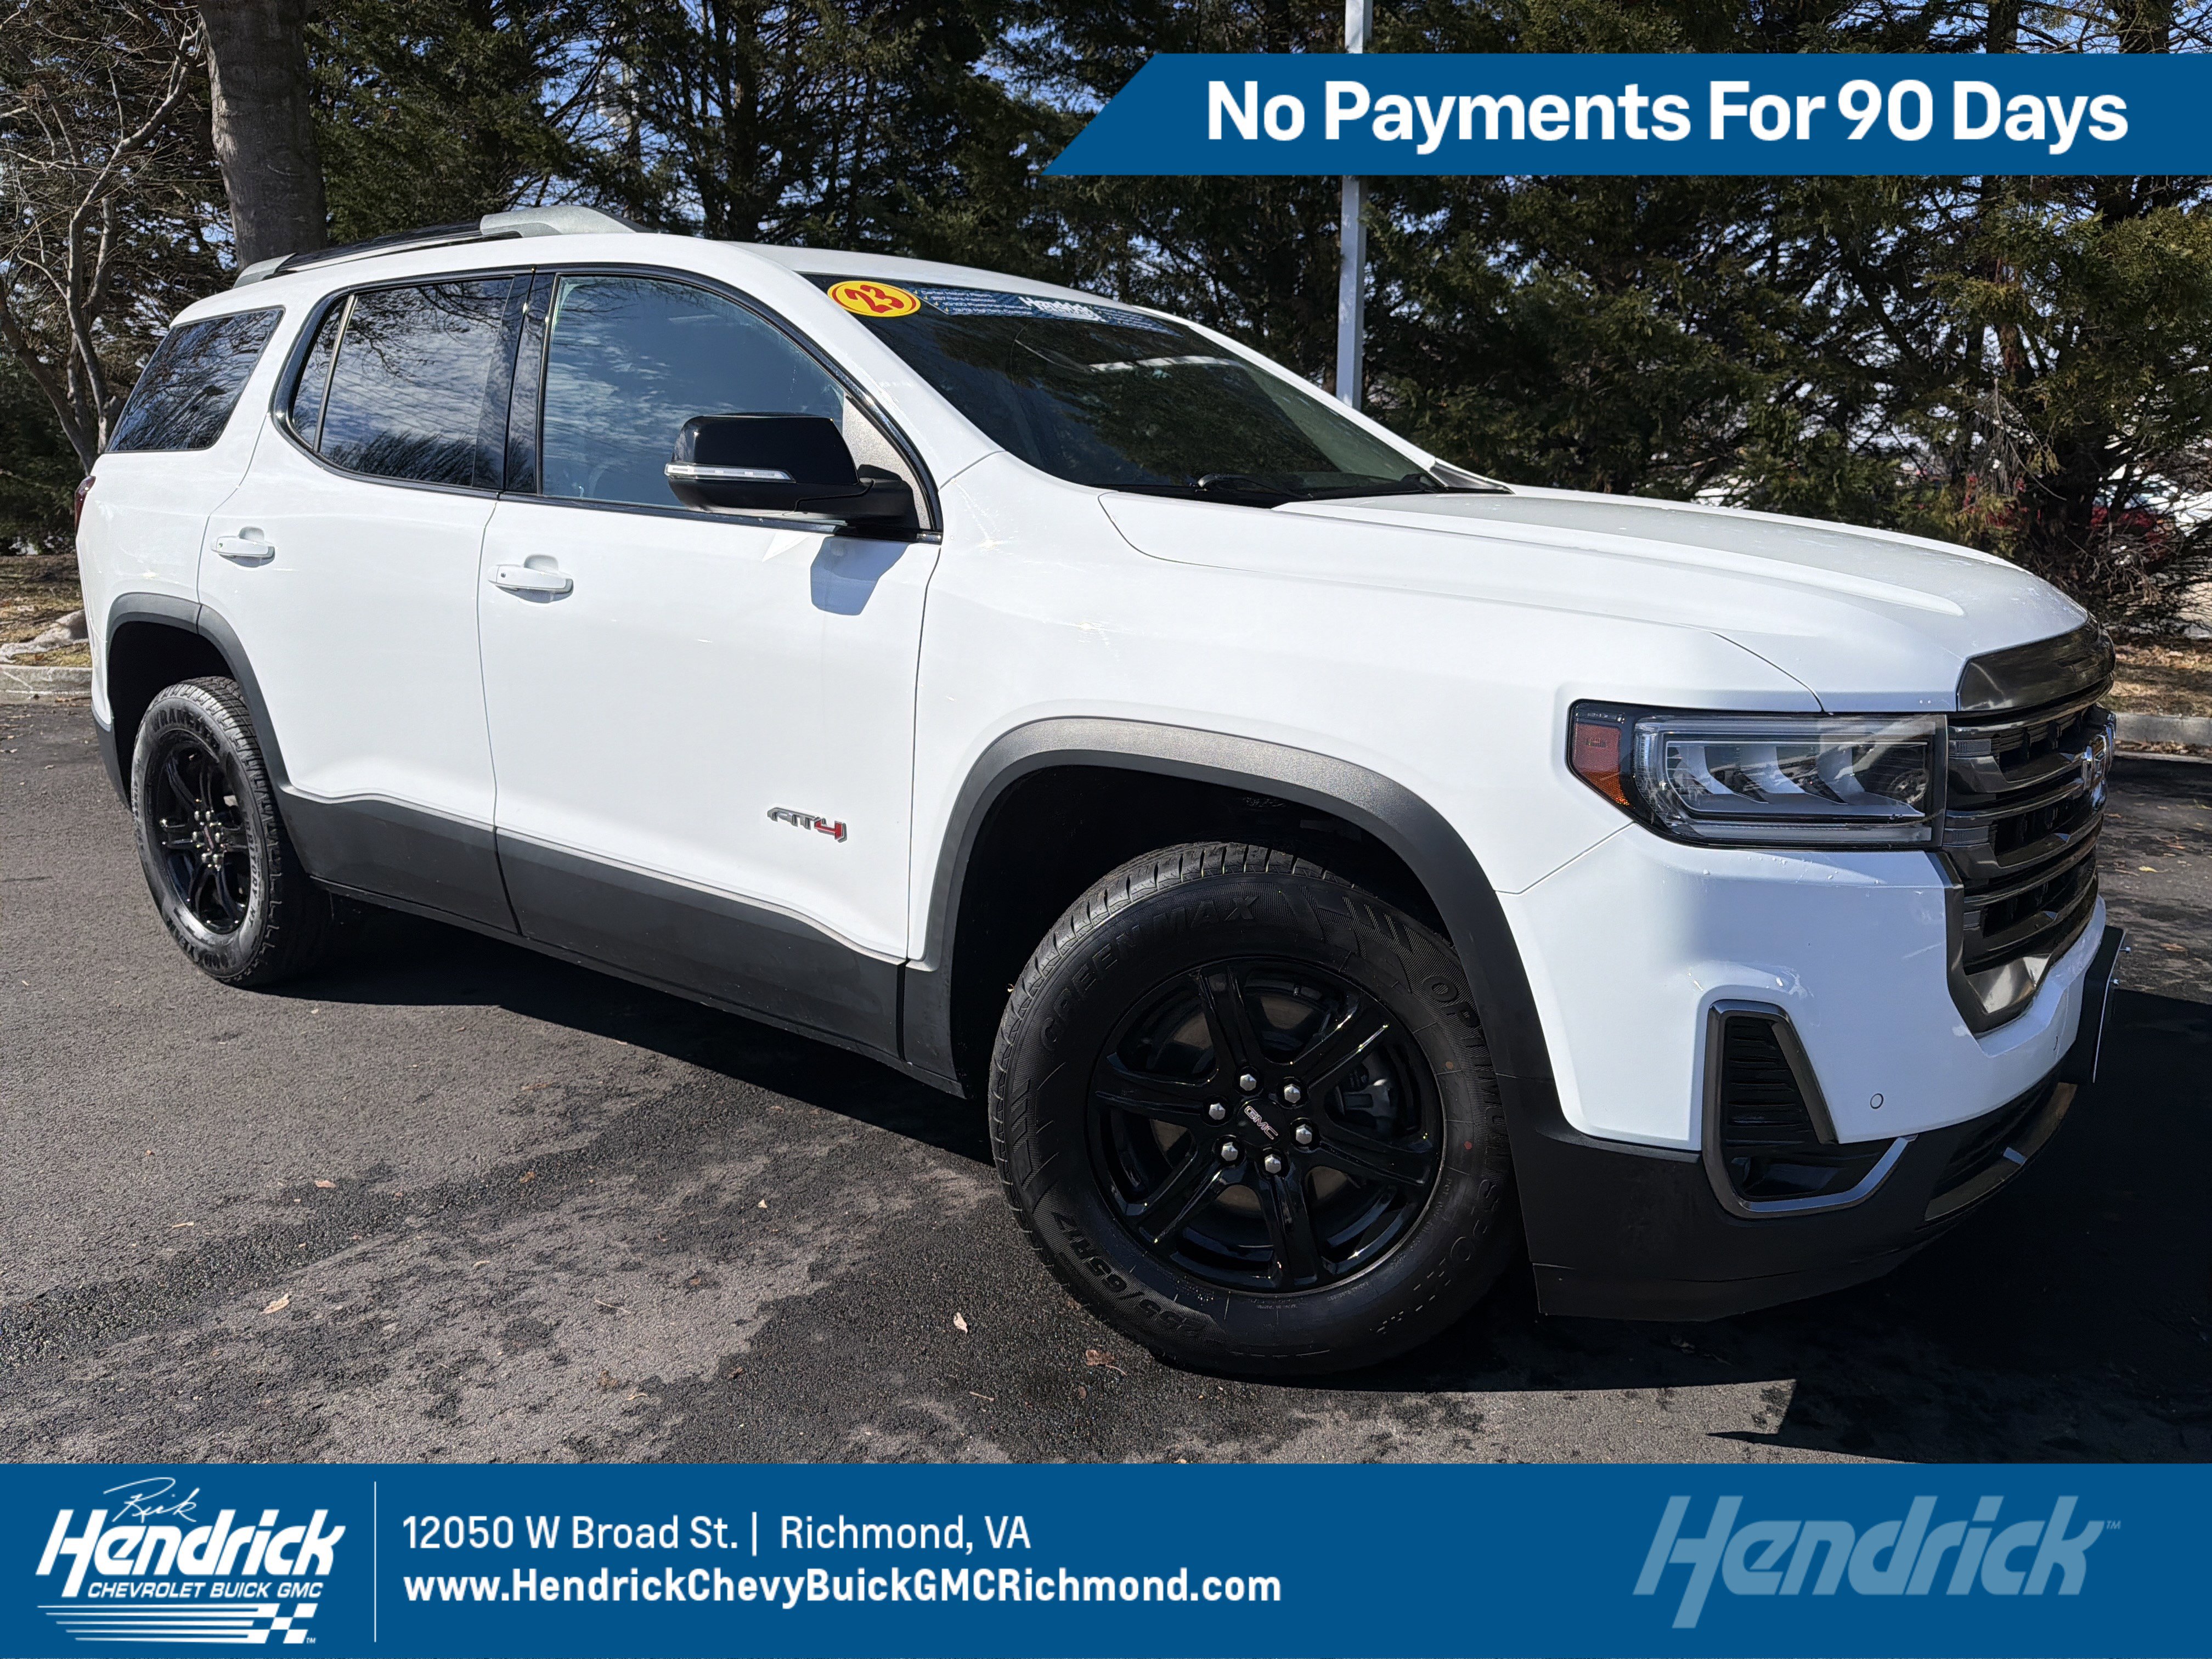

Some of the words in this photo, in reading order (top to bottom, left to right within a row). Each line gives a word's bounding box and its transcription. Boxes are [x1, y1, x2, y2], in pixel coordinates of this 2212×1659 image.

[844, 284, 905, 314] 23
[767, 806, 848, 843] AT4
[1244, 1105, 1279, 1140] GMC
